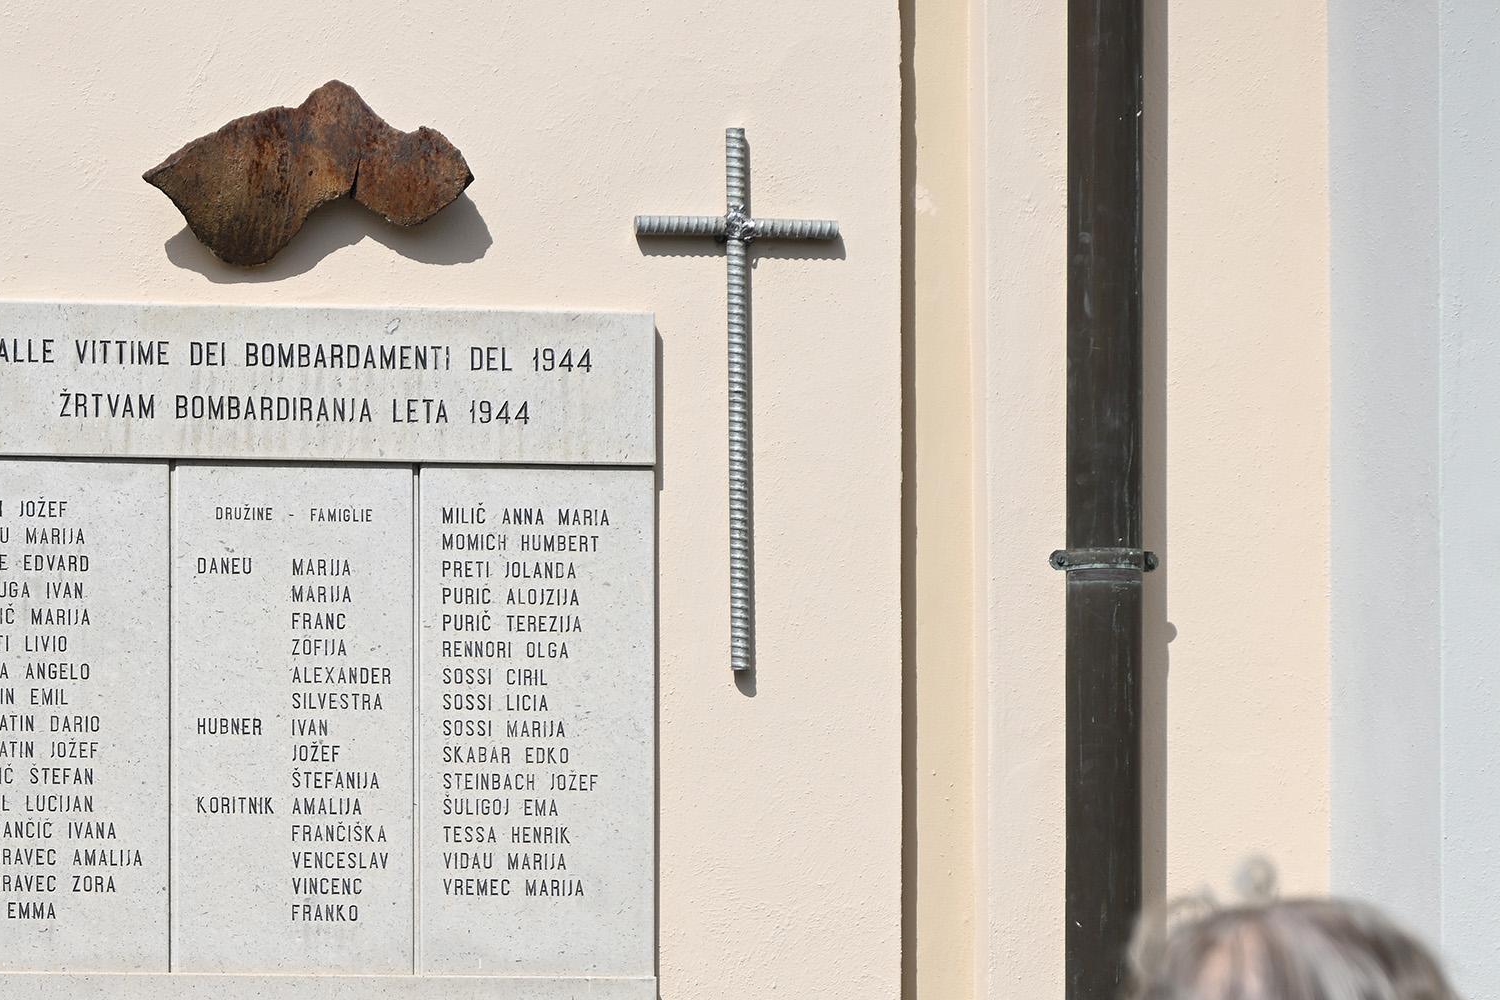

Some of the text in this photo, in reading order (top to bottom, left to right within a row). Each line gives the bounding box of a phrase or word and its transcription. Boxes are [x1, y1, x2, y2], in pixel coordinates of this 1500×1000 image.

[75, 340, 169, 365] VITTIME
[191, 342, 225, 366] DEI
[246, 343, 450, 370] BOMBARDAMENTI
[471, 347, 512, 371] DEL
[533, 348, 592, 373] 1944
[60, 388, 529, 425] ŽRTVAM BOMBARDIRANJA LETA 1944
[19, 496, 67, 517] JOŽEF
[216, 504, 272, 520] DRUŽINE
[311, 508, 372, 522] FAMIGLIE
[442, 502, 609, 526] MILIČ ANNA MARIA
[26, 527, 84, 544] MARIJA
[443, 534, 599, 552] MOMICH HUMBERT
[24, 555, 88, 571] EDVARD
[198, 557, 350, 576] DANEU MARIJA
[442, 561, 576, 579] PRETI JOLANDA
[47, 582, 82, 599] IVAN
[291, 585, 351, 602] MARIJA
[507, 588, 579, 606] ALOJZIJA
[31, 608, 90, 625] MARIJA
[292, 613, 345, 630] FRANC
[443, 610, 581, 632] PURIČ TEREZIJA
[26, 636, 67, 652] LIVIO
[292, 639, 346, 656] ZOFIJA
[443, 641, 568, 658] RENNORI OLGA
[26, 663, 89, 680] ANGELO
[289, 666, 390, 684] ALEXANDER
[443, 668, 547, 686] SOSSI CIRIL
[31, 688, 68, 705] EMIL
[292, 693, 382, 710] SILVESTRA
[443, 694, 548, 711] SOSSI LICIA
[51, 716, 99, 732] DARIO
[198, 718, 327, 736] HUBNER IVAN
[443, 720, 565, 737] SOSSI MARIJA
[51, 738, 98, 758] JOŽEF
[292, 740, 340, 762] JOŽEF
[526, 747, 568, 764] EDKO
[30, 763, 93, 785] ŠTEFAN
[292, 767, 379, 789] ŠTEFANIJA
[443, 770, 598, 791] STEINBACH JOŽEF
[26, 795, 93, 812] LUCIJAN
[196, 796, 361, 815] KORITNIK AMALIJA
[524, 799, 558, 816] EMA
[69, 822, 116, 839] IVANA
[443, 826, 570, 844] TESSA HENRIK
[73, 849, 142, 866] AMALIJA
[292, 852, 388, 869] VENCESLAV
[443, 853, 566, 870] VIDAU MARIJA
[73, 876, 116, 892] ZORA
[292, 878, 362, 895] VINCENC
[443, 879, 584, 896] VREMEC MARIJA
[8, 902, 56, 919] EMMA
[292, 904, 357, 921] FRANKO
